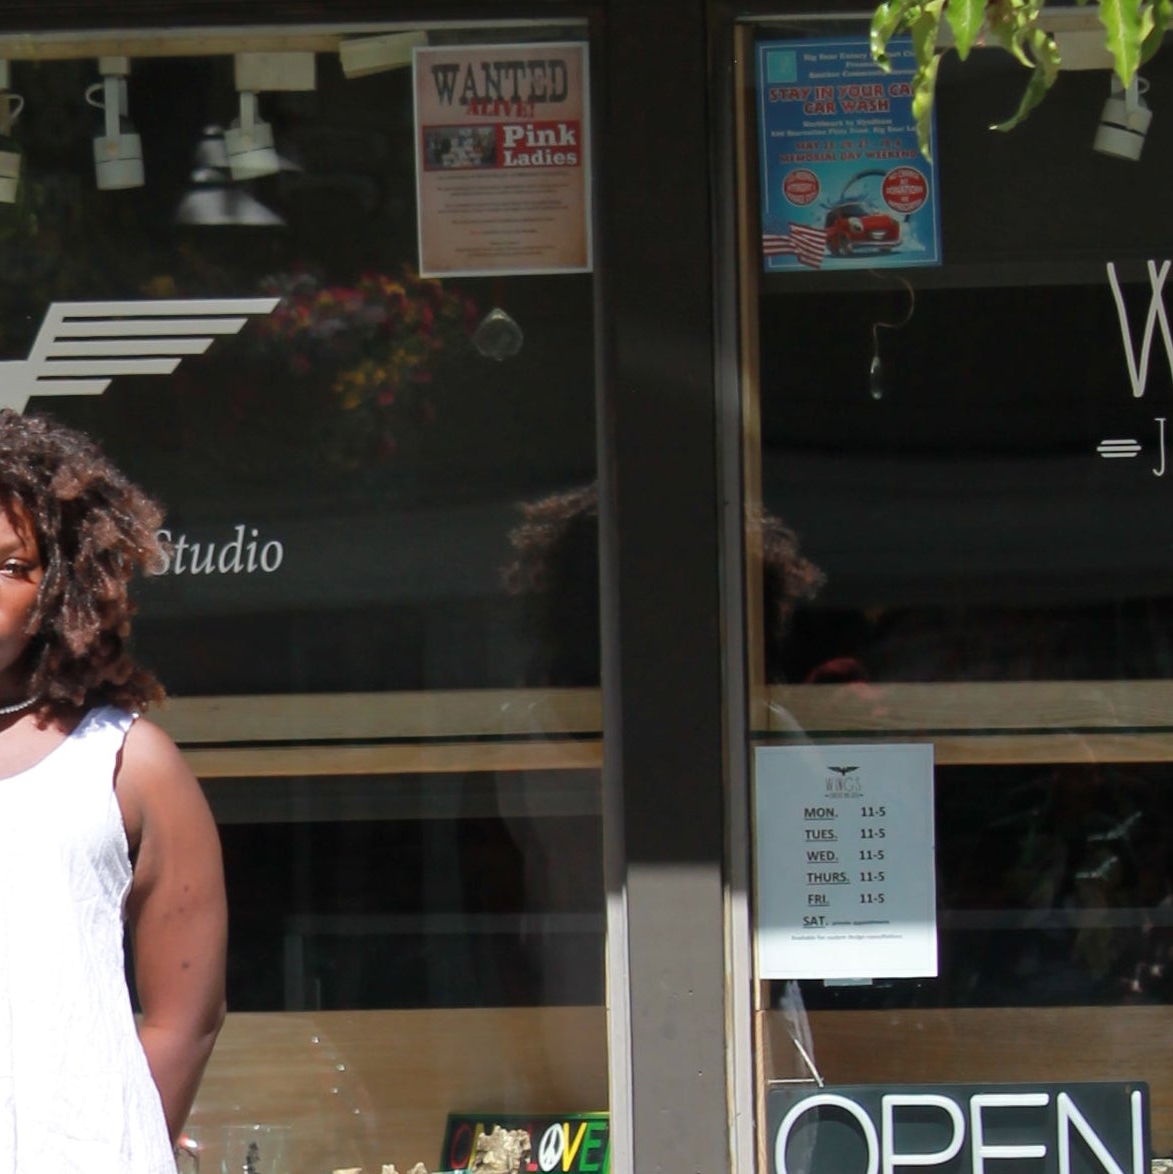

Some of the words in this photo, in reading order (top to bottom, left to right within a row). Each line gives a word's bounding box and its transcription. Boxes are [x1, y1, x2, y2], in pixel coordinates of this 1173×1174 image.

[431, 60, 569, 106] WANTED
[770, 86, 811, 102] STAY
[815, 86, 834, 100] IN
[839, 83, 884, 98] YOUR
[889, 83, 914, 96] CA
[803, 101, 837, 115] CAR
[841, 98, 890, 114] WASH
[503, 123, 576, 148] Pink
[504, 149, 577, 167] Ladies
[152, 524, 284, 576] Studio
[825, 776, 862, 792] WINGS
[804, 807, 839, 819] MON.
[861, 806, 886, 817] 11-5
[805, 829, 838, 841] TUES.
[860, 828, 886, 839] 11-5
[807, 850, 839, 862] WED.
[859, 850, 884, 861] 11-5
[807, 872, 850, 884] THURS.
[859, 871, 885, 882] 11-5
[807, 893, 830, 905] FRI.
[859, 893, 885, 904] 11-5
[802, 916, 828, 927] SAT.
